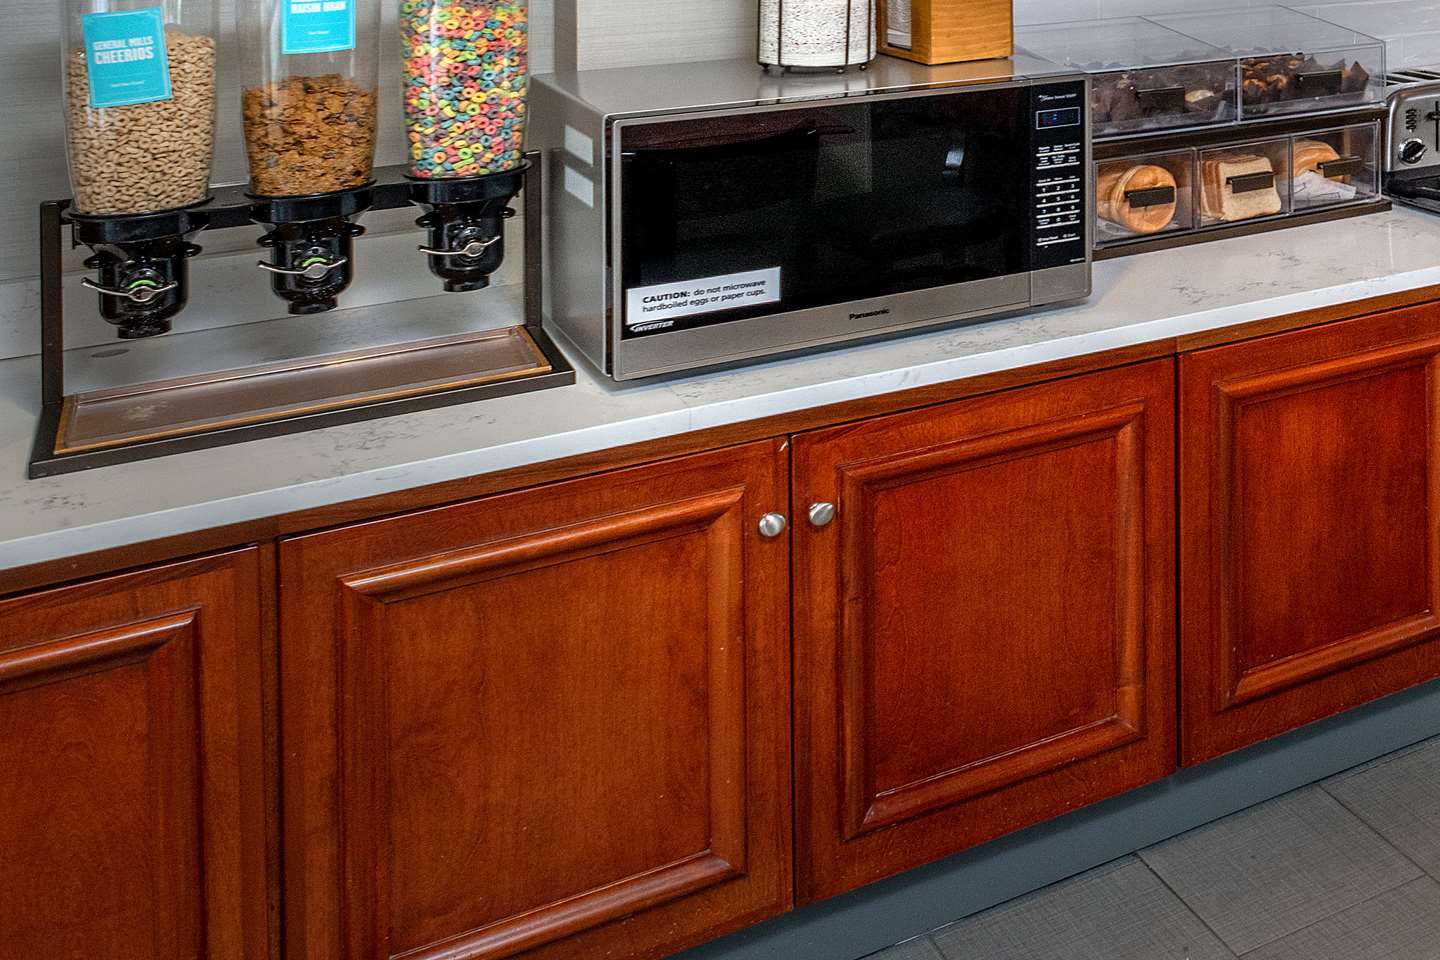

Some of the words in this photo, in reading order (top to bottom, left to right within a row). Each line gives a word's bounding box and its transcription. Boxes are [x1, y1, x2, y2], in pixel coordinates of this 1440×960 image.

[93, 46, 155, 65] CHEERIOS
[642, 290, 691, 304] CAUTION:
[693, 288, 705, 296] do
[706, 286, 721, 295] not
[722, 280, 766, 292] microwave
[642, 299, 688, 313] hardboiled
[689, 297, 709, 307] eggs
[721, 292, 745, 303] paper
[746, 288, 766, 298] cups.
[849, 309, 890, 320] Panasonic
[634, 320, 675, 332] INVERTER
